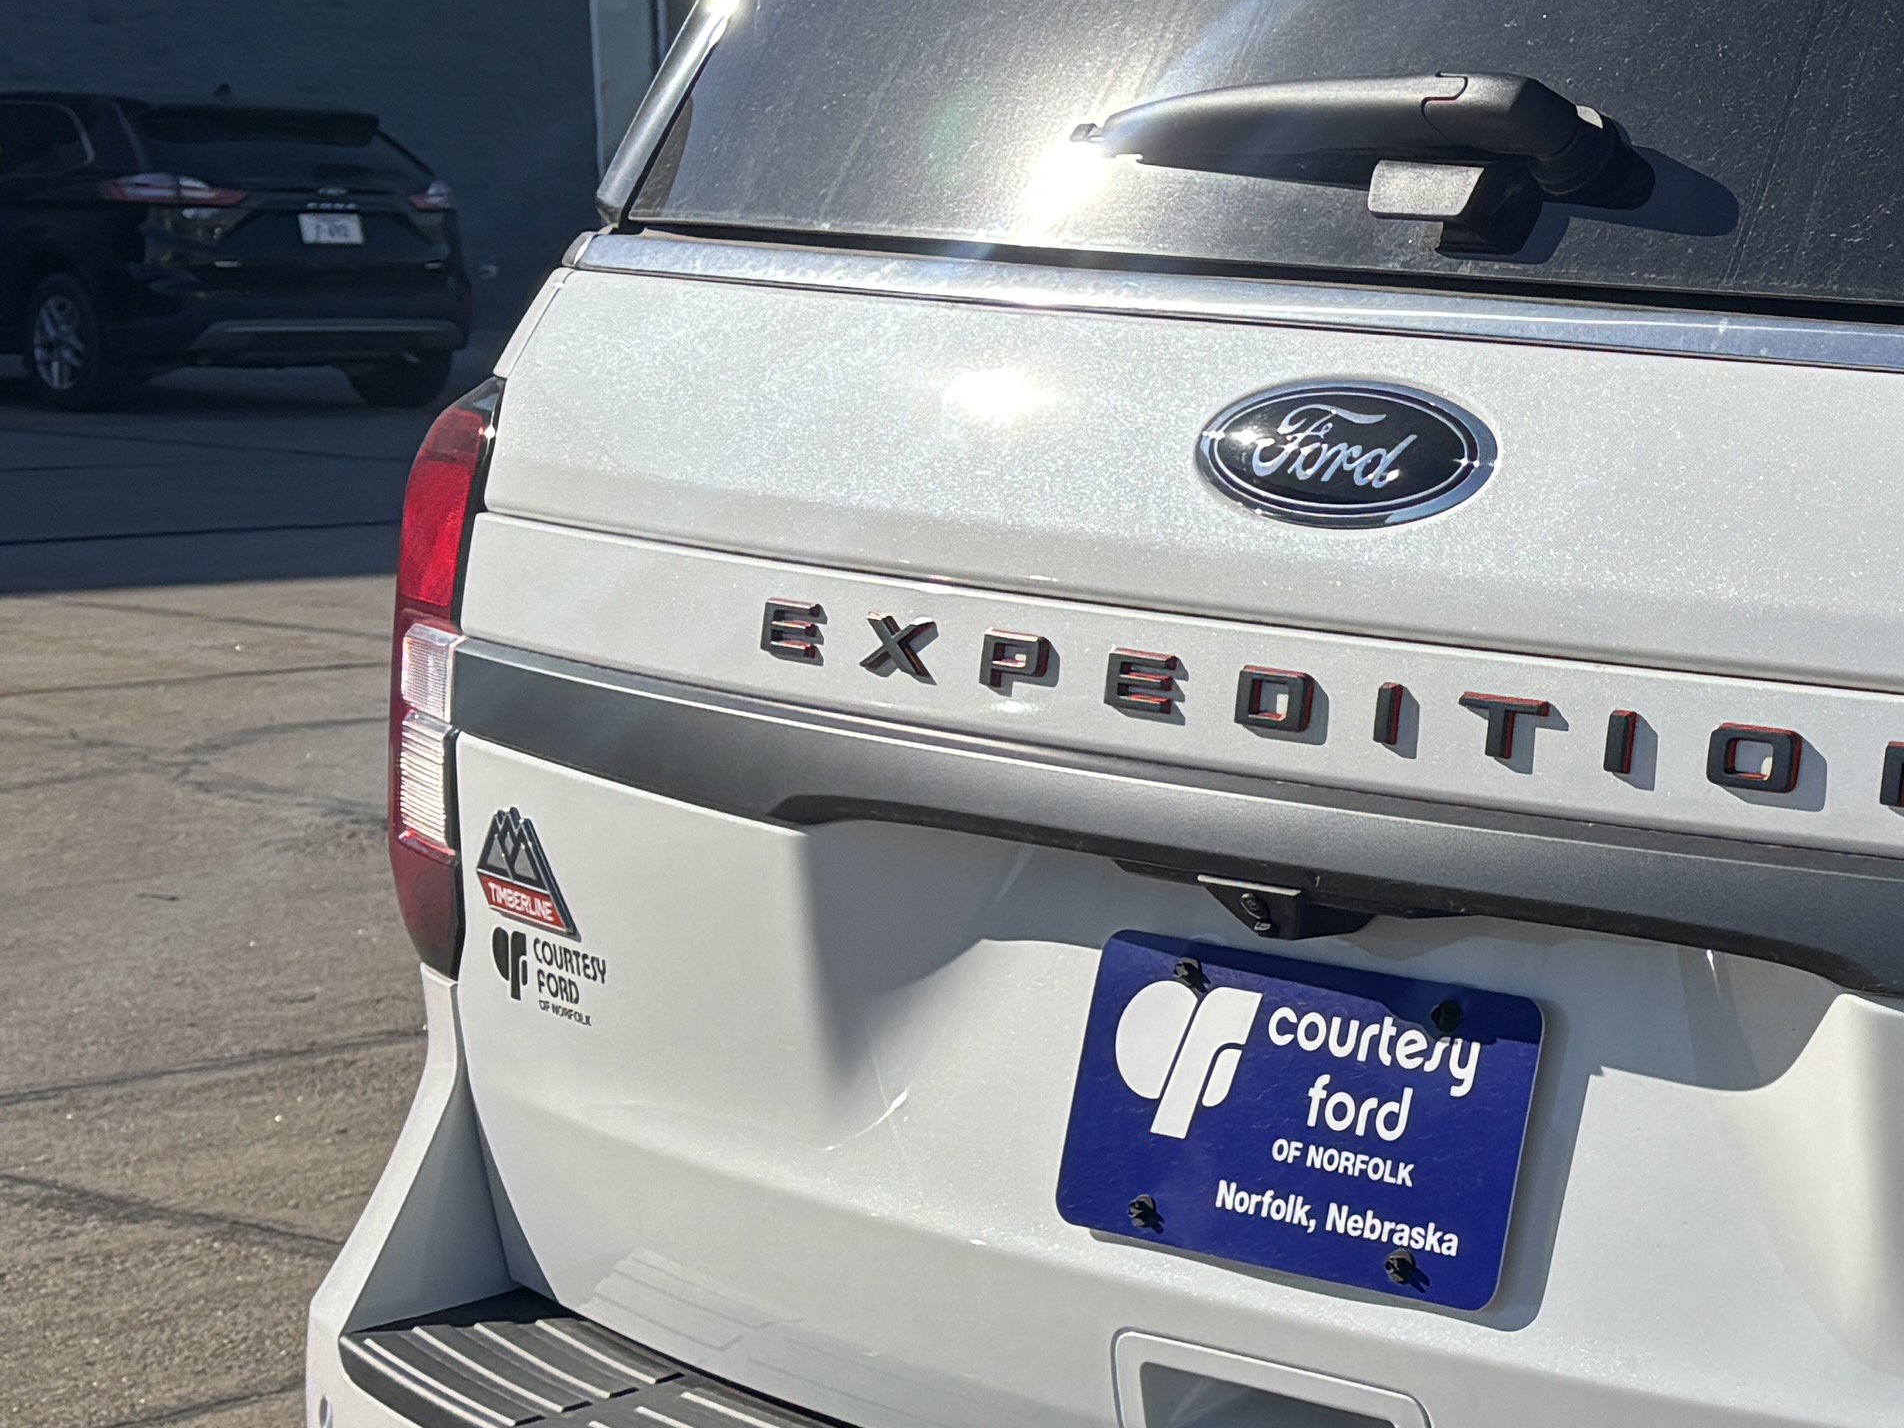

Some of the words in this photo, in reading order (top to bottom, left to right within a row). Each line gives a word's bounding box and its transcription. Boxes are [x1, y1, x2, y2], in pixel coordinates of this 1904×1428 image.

[1252, 403, 1418, 489] Ford
[488, 881, 555, 922] TIMBERLINE
[533, 937, 607, 984] COURTESY
[537, 968, 580, 1005] FORD
[539, 999, 550, 1012] OF
[1268, 1006, 1482, 1098] courtesy
[1306, 1074, 1413, 1142] ford
[1272, 1138, 1303, 1164] OF
[1306, 1144, 1415, 1187] NORFOLK
[1215, 1179, 1317, 1235] Norfolk,
[1325, 1202, 1459, 1257] Nebraska
